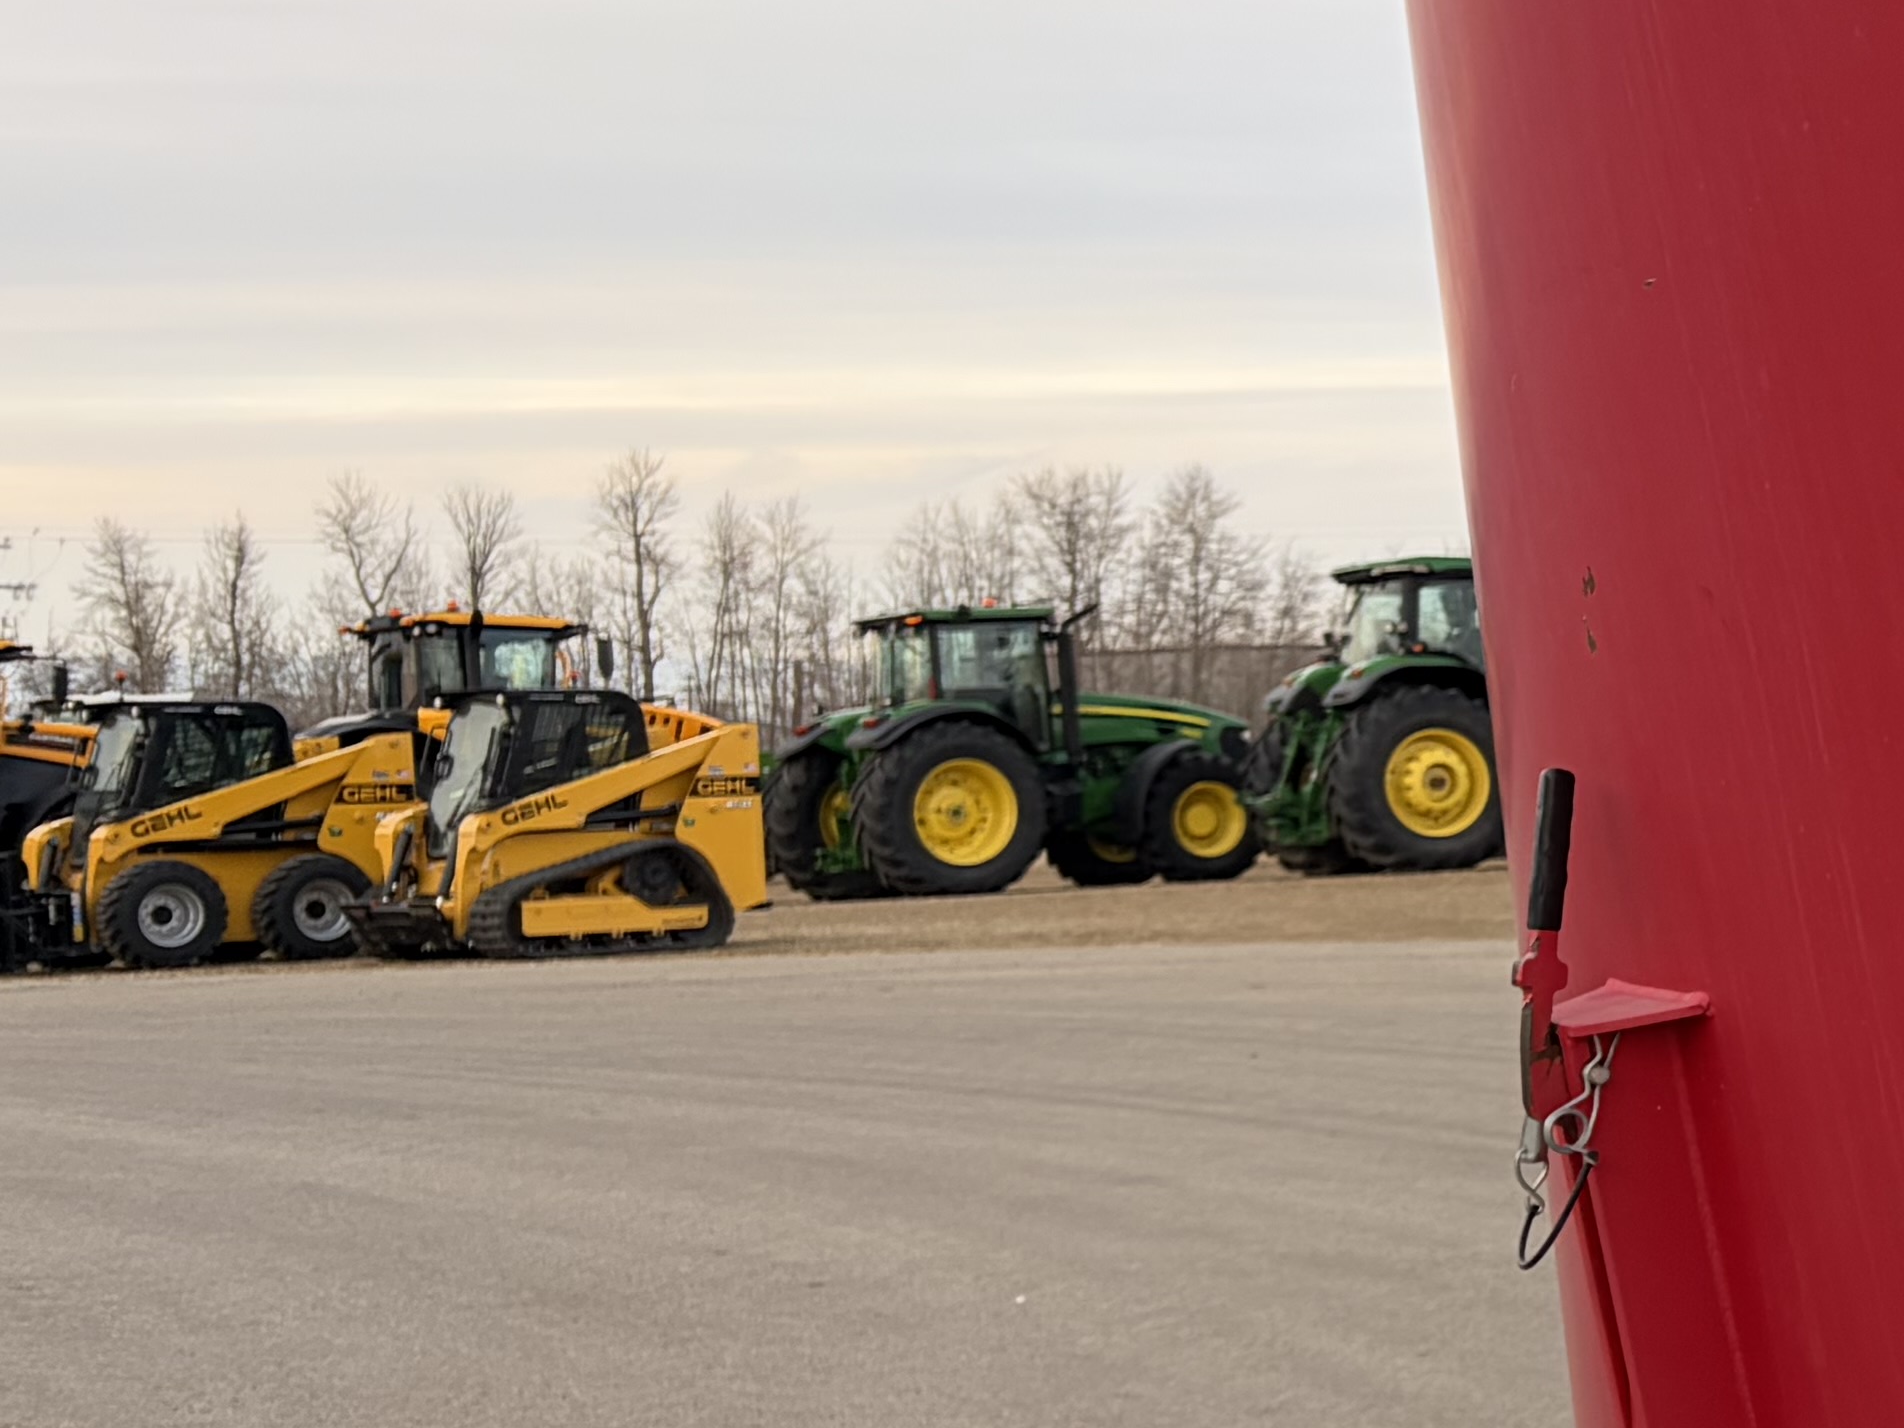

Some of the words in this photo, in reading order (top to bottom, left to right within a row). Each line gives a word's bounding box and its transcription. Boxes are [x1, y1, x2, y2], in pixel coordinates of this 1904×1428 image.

[342, 786, 407, 803] GEHL
[697, 778, 755, 796] GEHL
[131, 805, 202, 838] GEHL
[501, 795, 569, 825] GEHL
